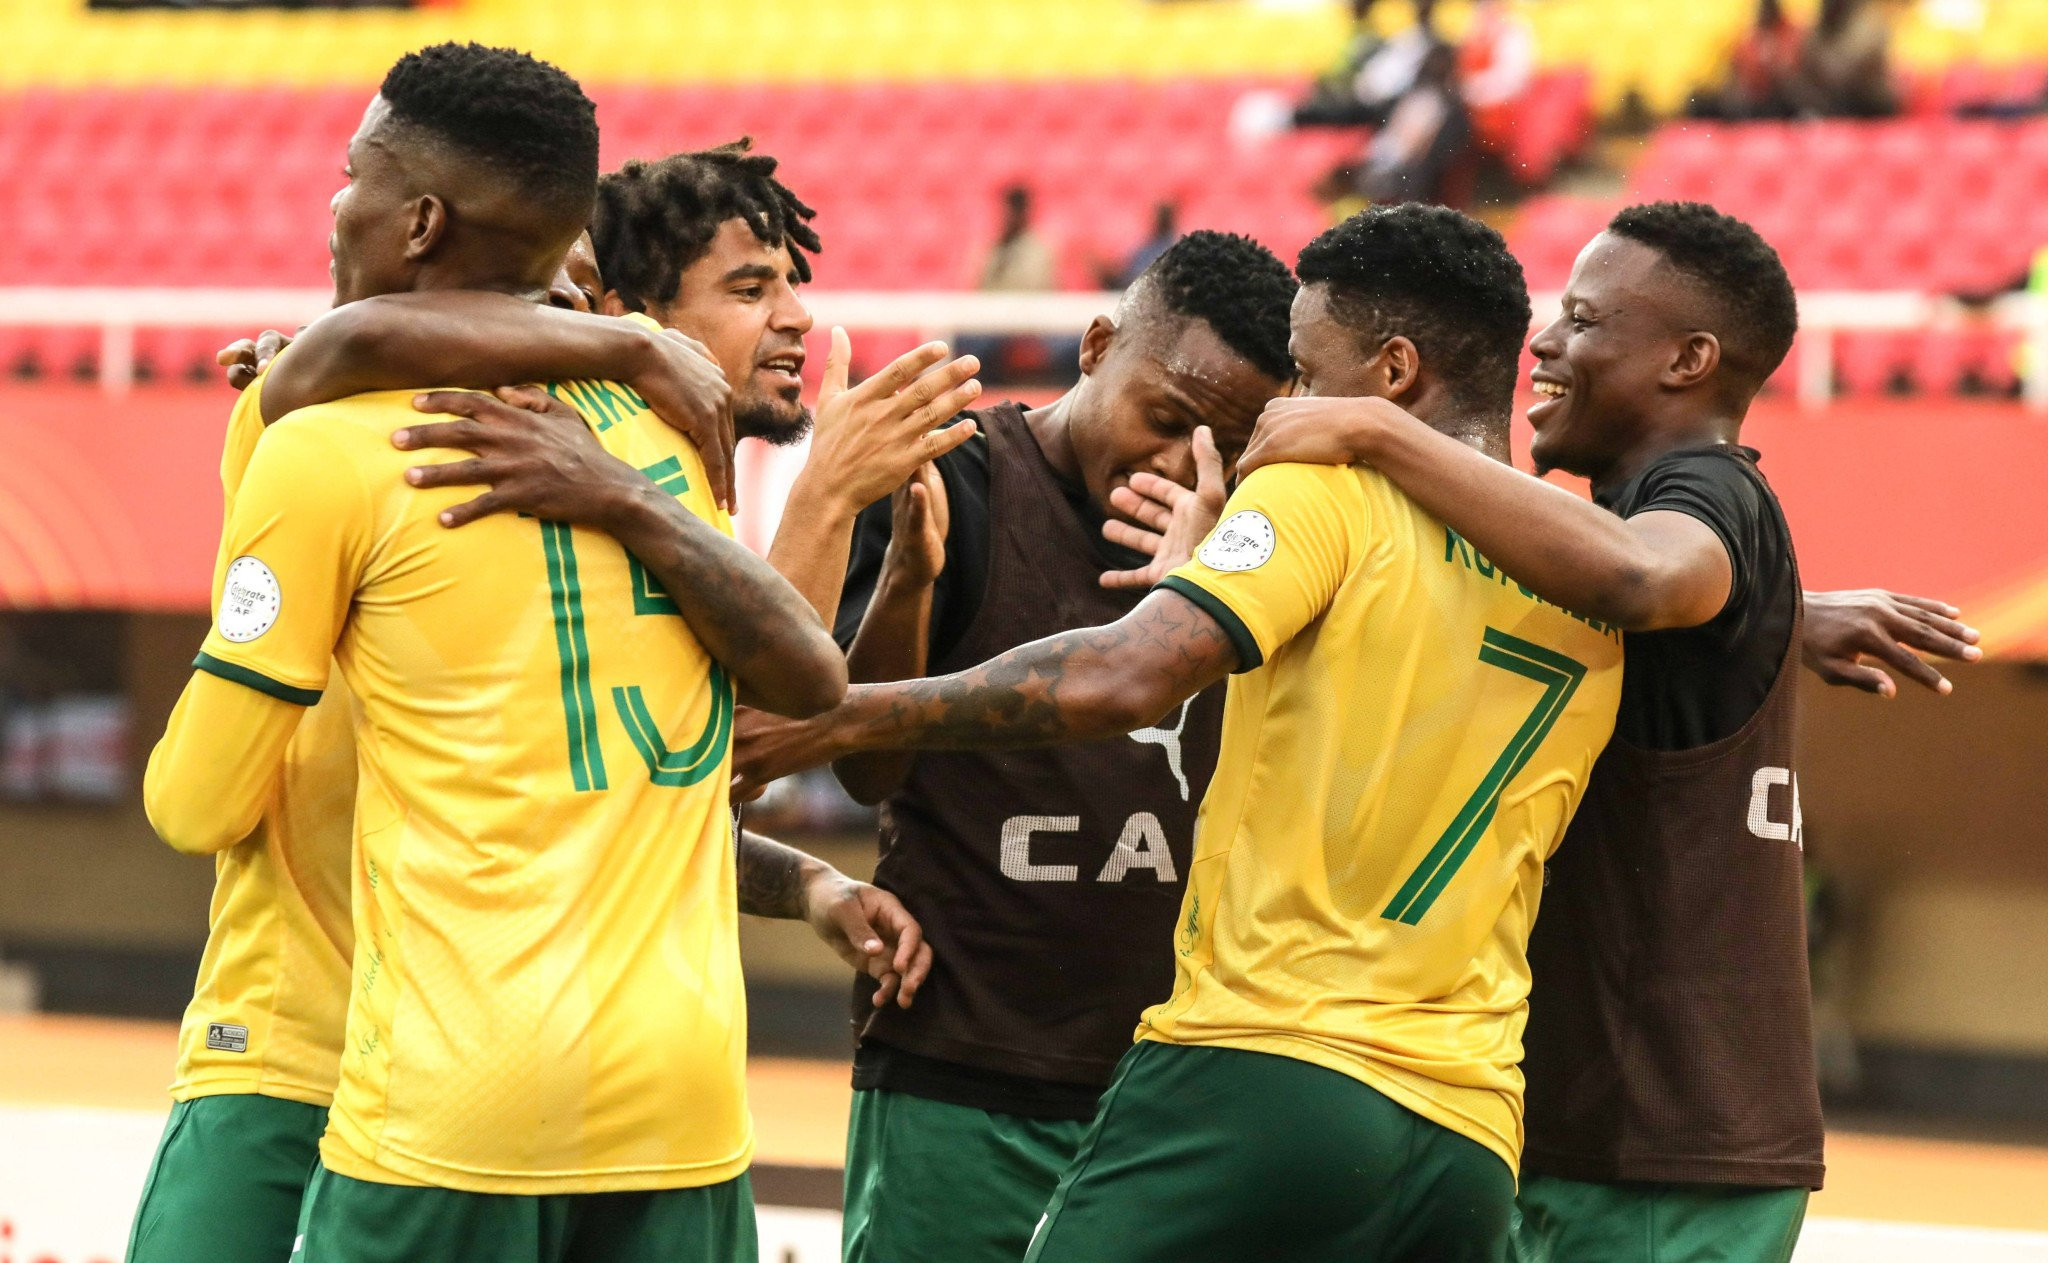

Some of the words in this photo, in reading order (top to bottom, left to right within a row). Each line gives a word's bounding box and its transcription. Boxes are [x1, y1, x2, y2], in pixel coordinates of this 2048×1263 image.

[518, 455, 736, 791] 15
[1221, 529, 1260, 549] Celate
[1000, 811, 1201, 882] CA
[1380, 625, 1589, 926] 7
